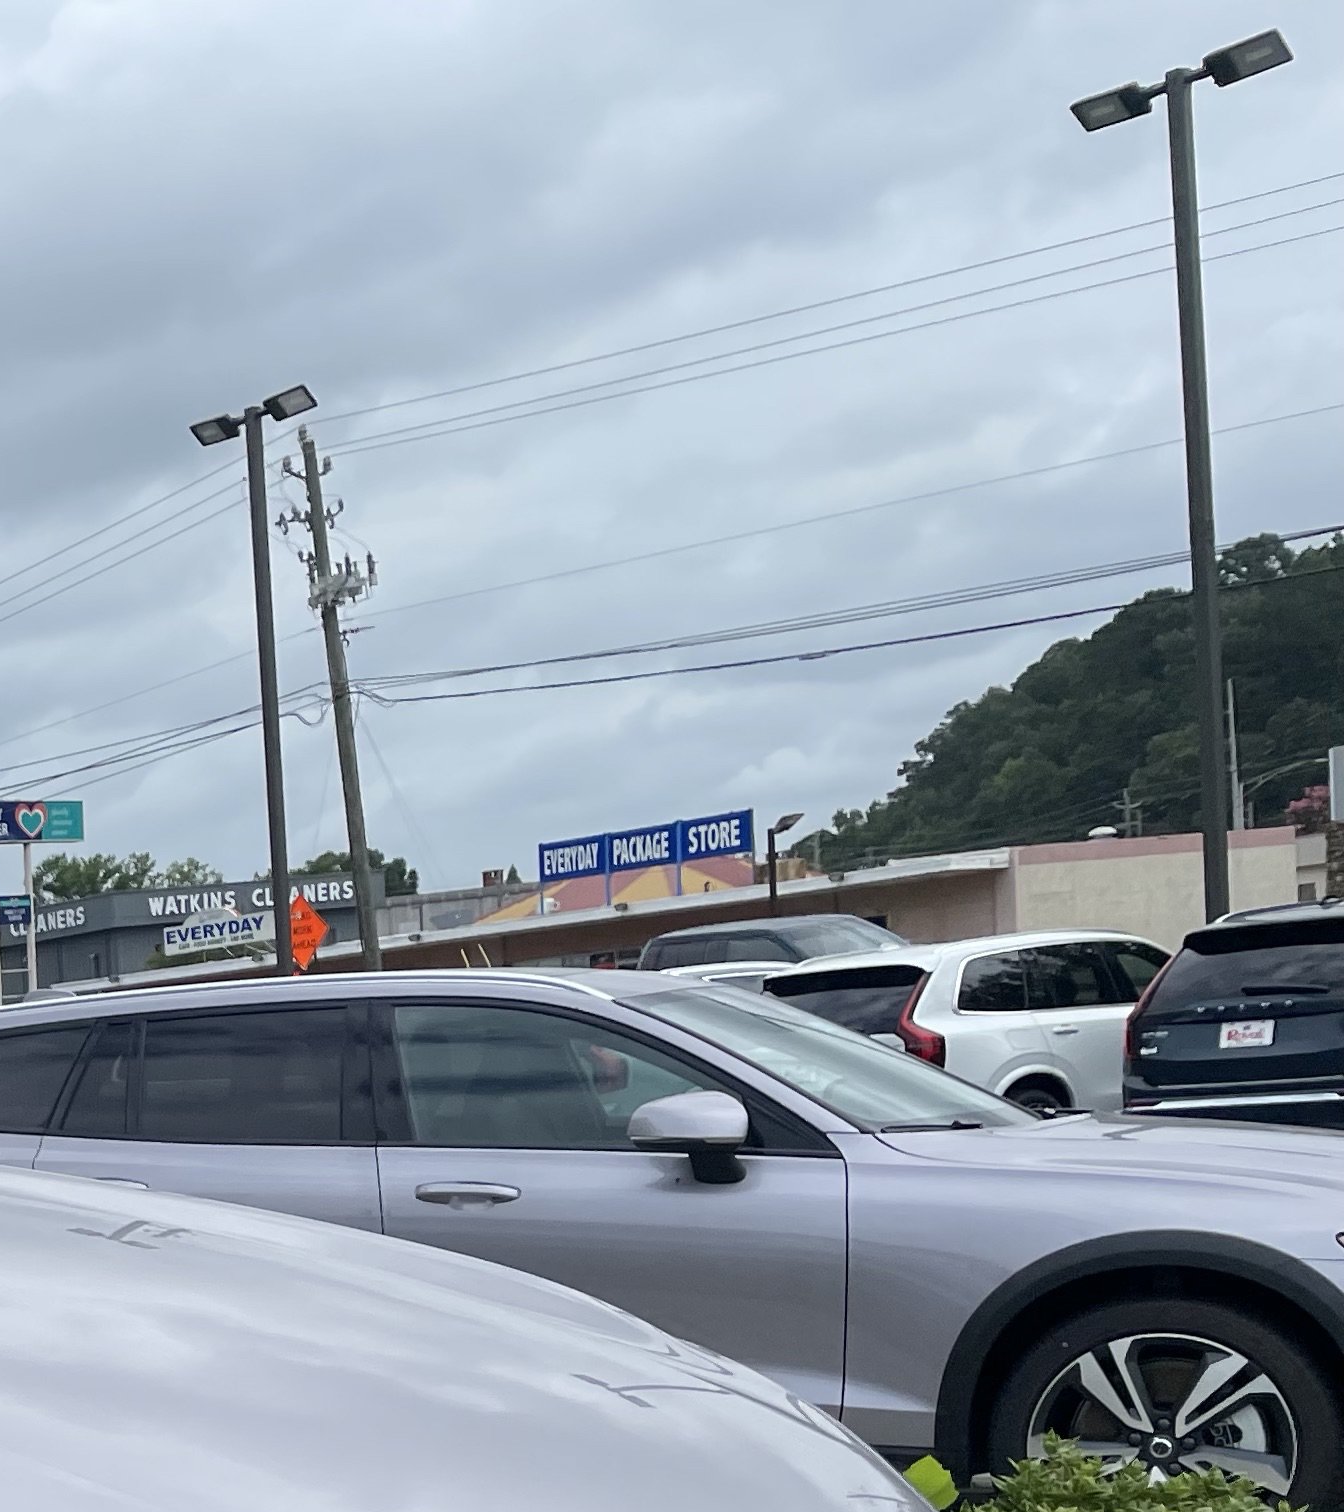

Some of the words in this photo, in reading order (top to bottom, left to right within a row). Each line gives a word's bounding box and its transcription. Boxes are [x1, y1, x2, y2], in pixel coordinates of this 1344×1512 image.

[543, 842, 599, 876] EVERYDAY
[613, 831, 670, 866] PACKAGE
[687, 819, 741, 854] STORE
[148, 890, 236, 917] WATKINS
[251, 880, 354, 908] CLANERS
[9, 906, 85, 937] CLANERS
[166, 915, 264, 945] EVERYDAY
